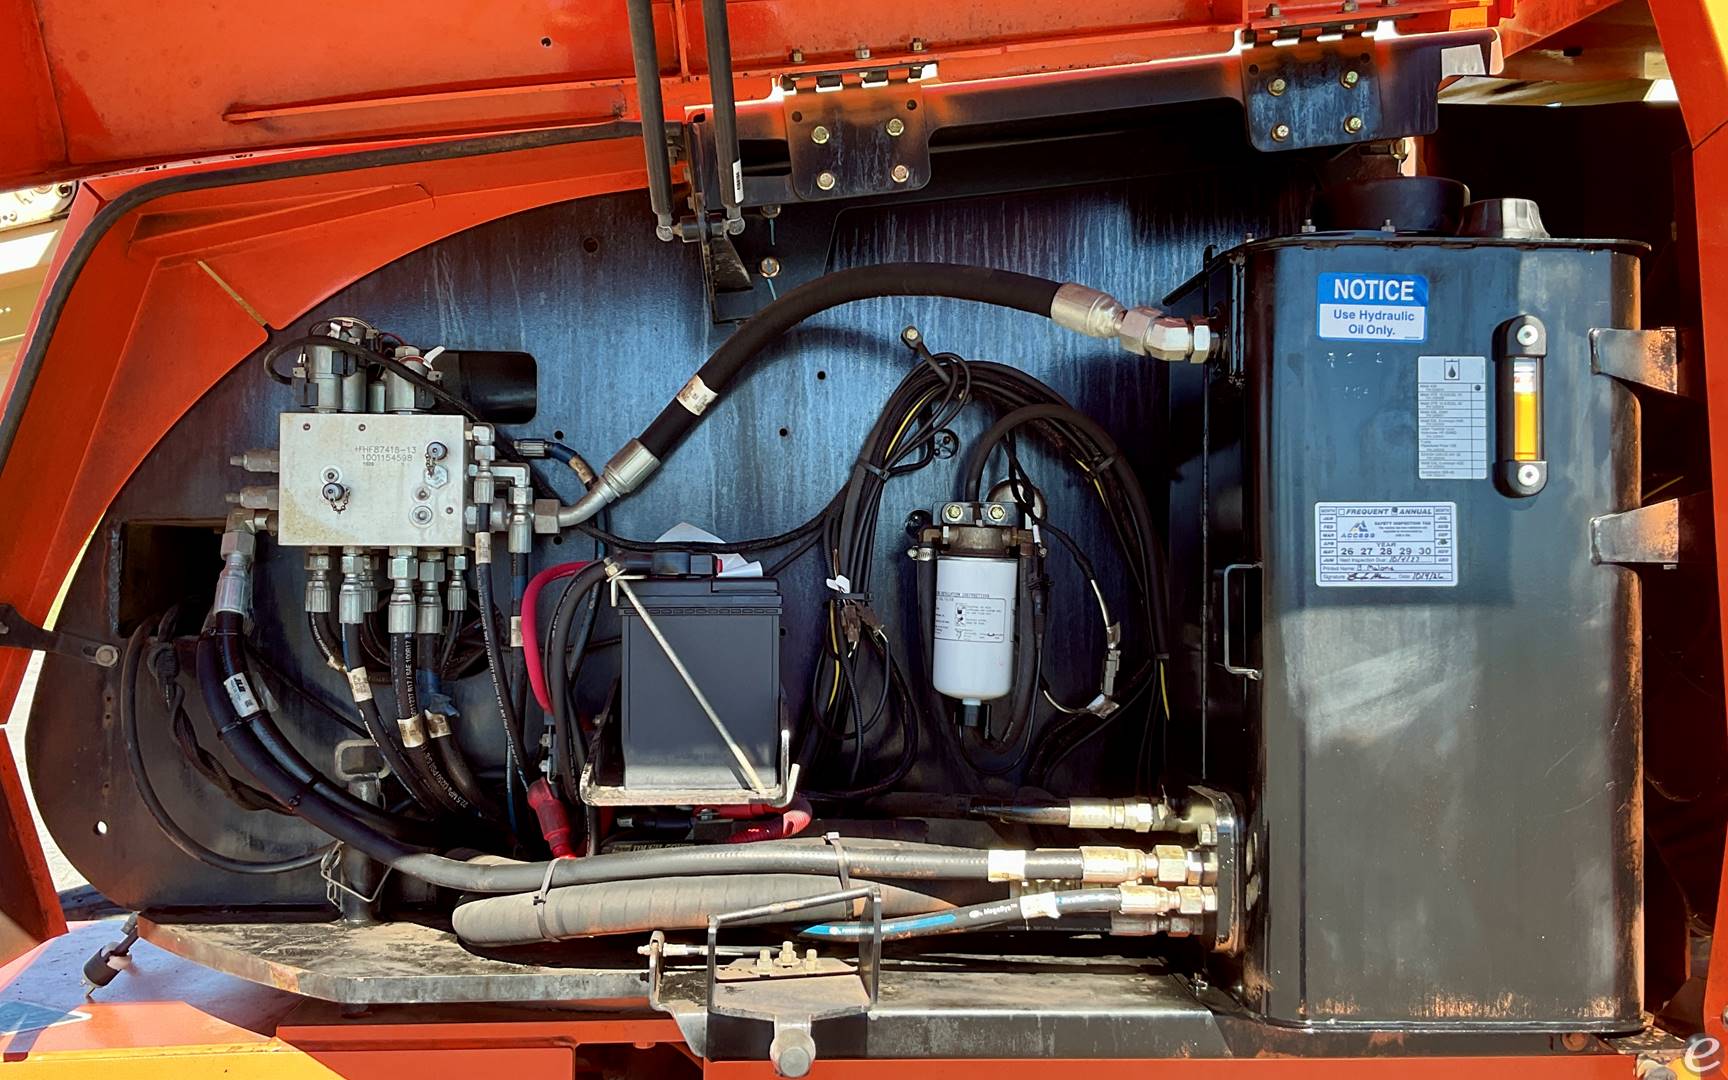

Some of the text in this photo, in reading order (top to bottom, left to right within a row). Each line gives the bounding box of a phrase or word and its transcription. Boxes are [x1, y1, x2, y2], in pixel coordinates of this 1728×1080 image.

[1334, 278, 1415, 301] NOTICE
[1333, 309, 1415, 322] Use Hydraulic
[1348, 324, 1396, 337] Oil Only.
[1340, 547, 1431, 555] 26 27 28 29 30
